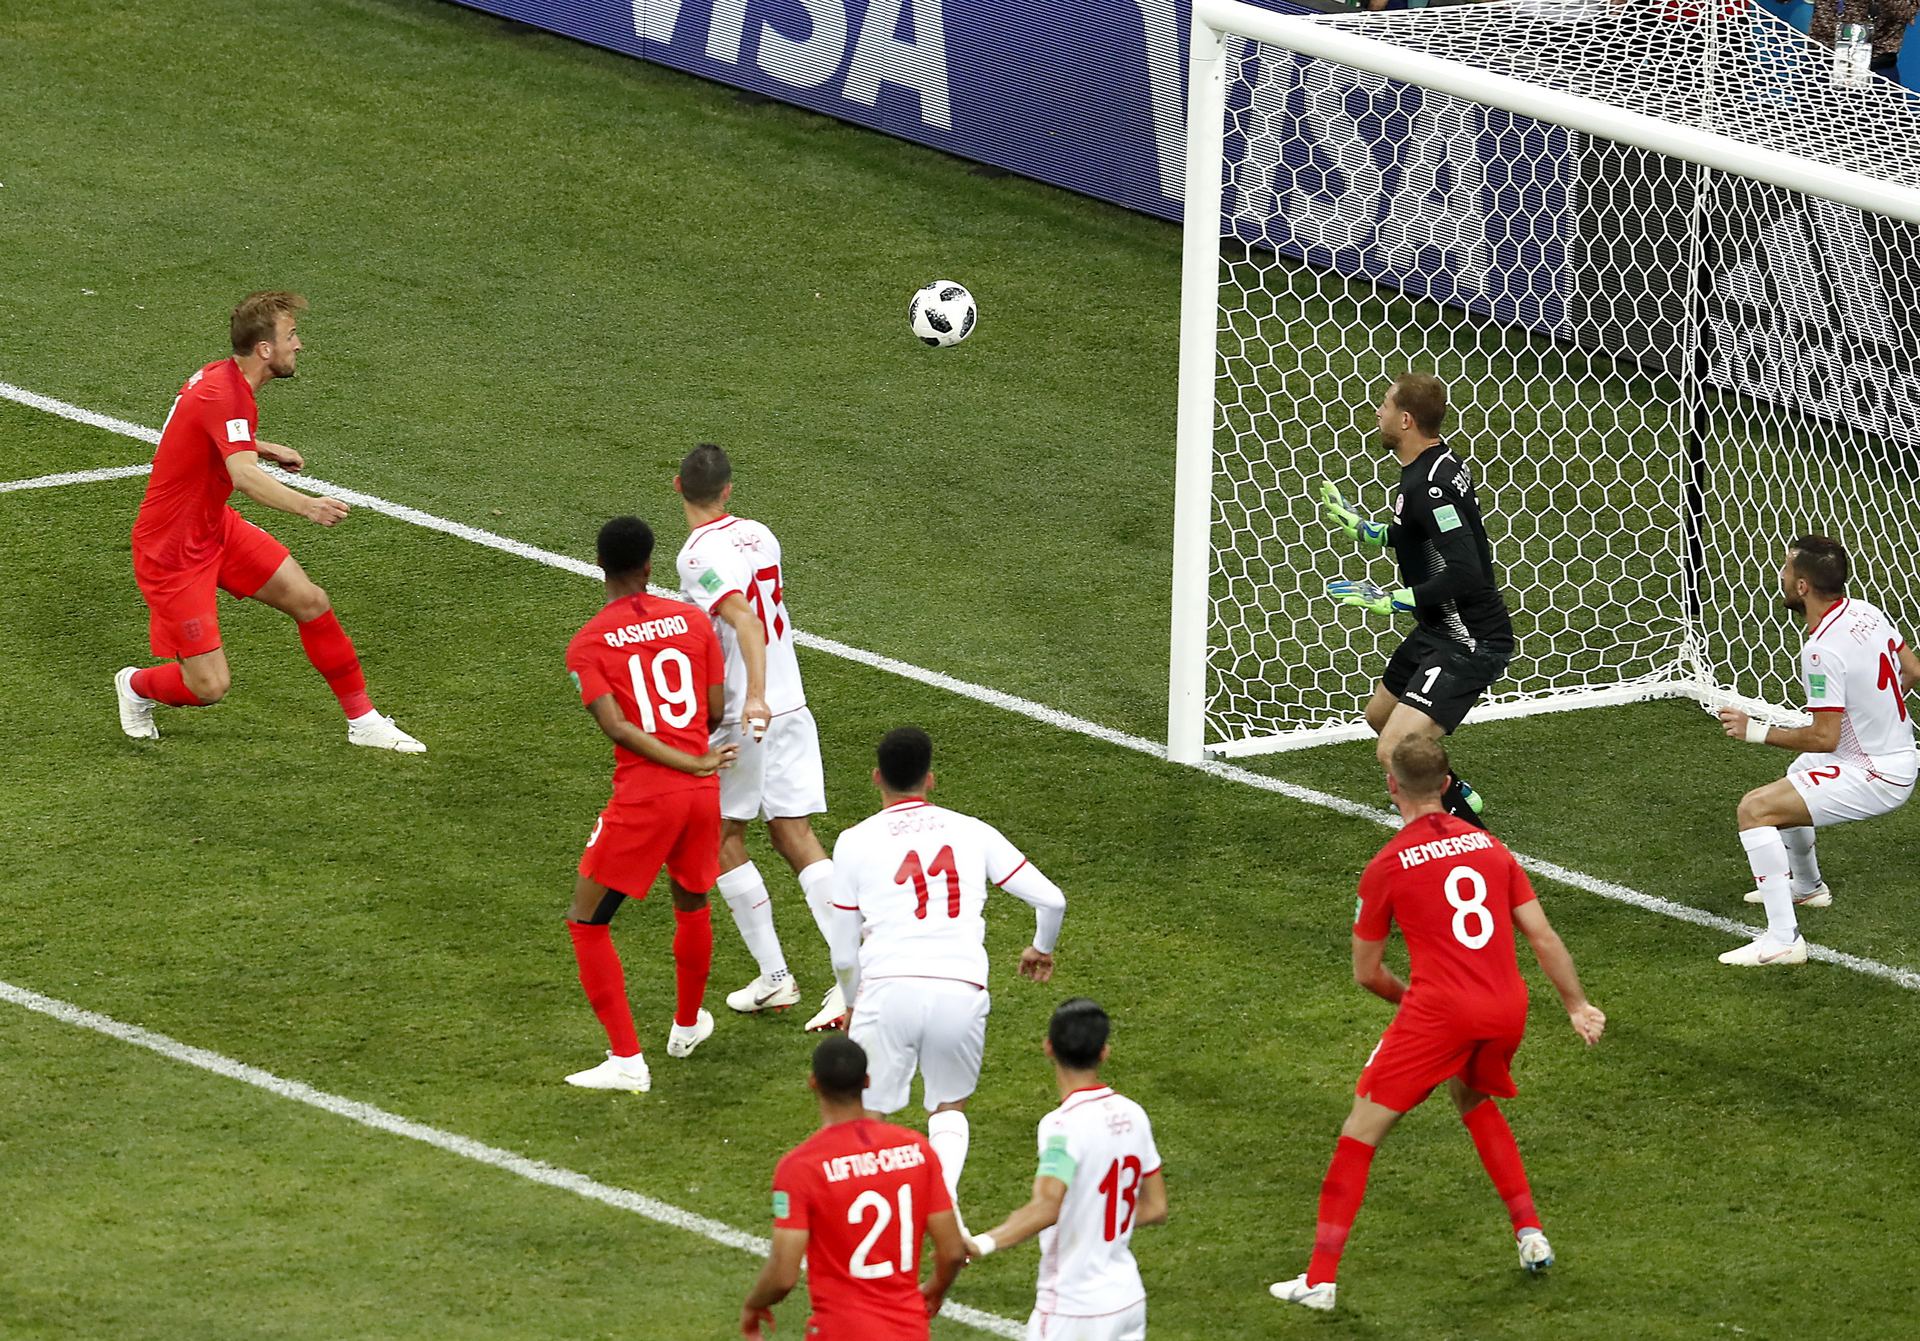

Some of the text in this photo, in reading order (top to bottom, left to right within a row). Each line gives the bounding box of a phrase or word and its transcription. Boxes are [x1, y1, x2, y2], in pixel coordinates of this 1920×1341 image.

[631, 0, 952, 131] SA
[603, 615, 689, 648] RASHFORD
[628, 647, 698, 733] 19
[1421, 666, 1442, 694] 1
[1877, 638, 1907, 722] 1
[894, 844, 961, 919] 11
[1398, 831, 1494, 870] HENDERSON
[1444, 865, 1495, 950] 8
[822, 1143, 926, 1183] LOFTUS-CHEEK
[1098, 1155, 1142, 1242] 13
[847, 1183, 914, 1280] 21
